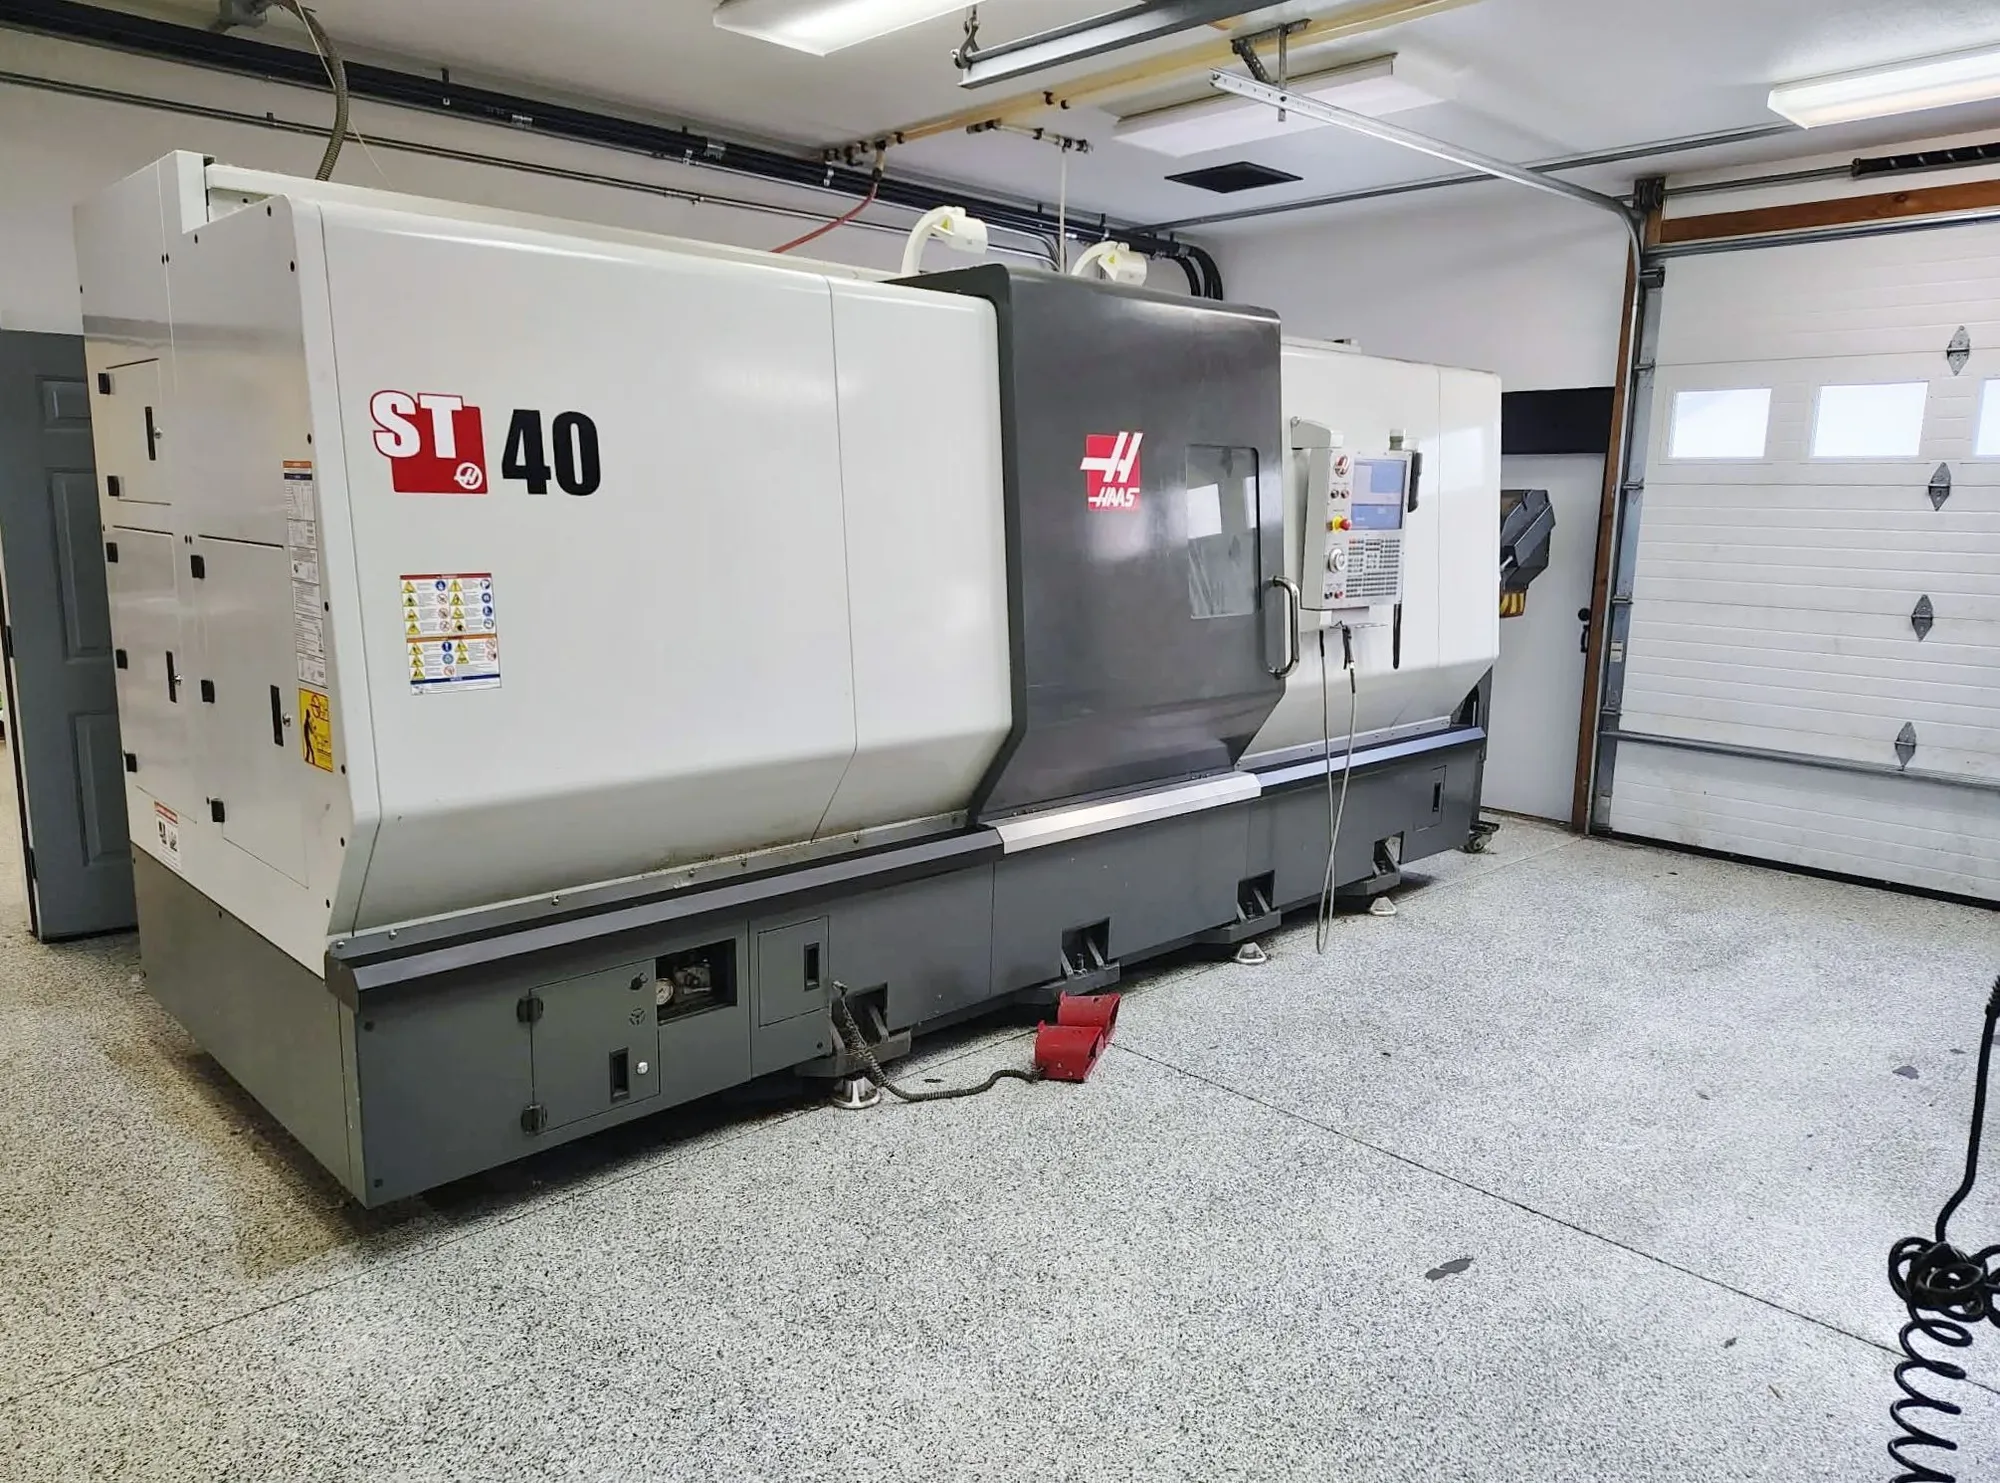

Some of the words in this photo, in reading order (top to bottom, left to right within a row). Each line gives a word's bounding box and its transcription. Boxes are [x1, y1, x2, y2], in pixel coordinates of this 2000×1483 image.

[370, 390, 463, 459] ST
[502, 409, 601, 496] 40
[1088, 487, 1140, 507] HAAS
